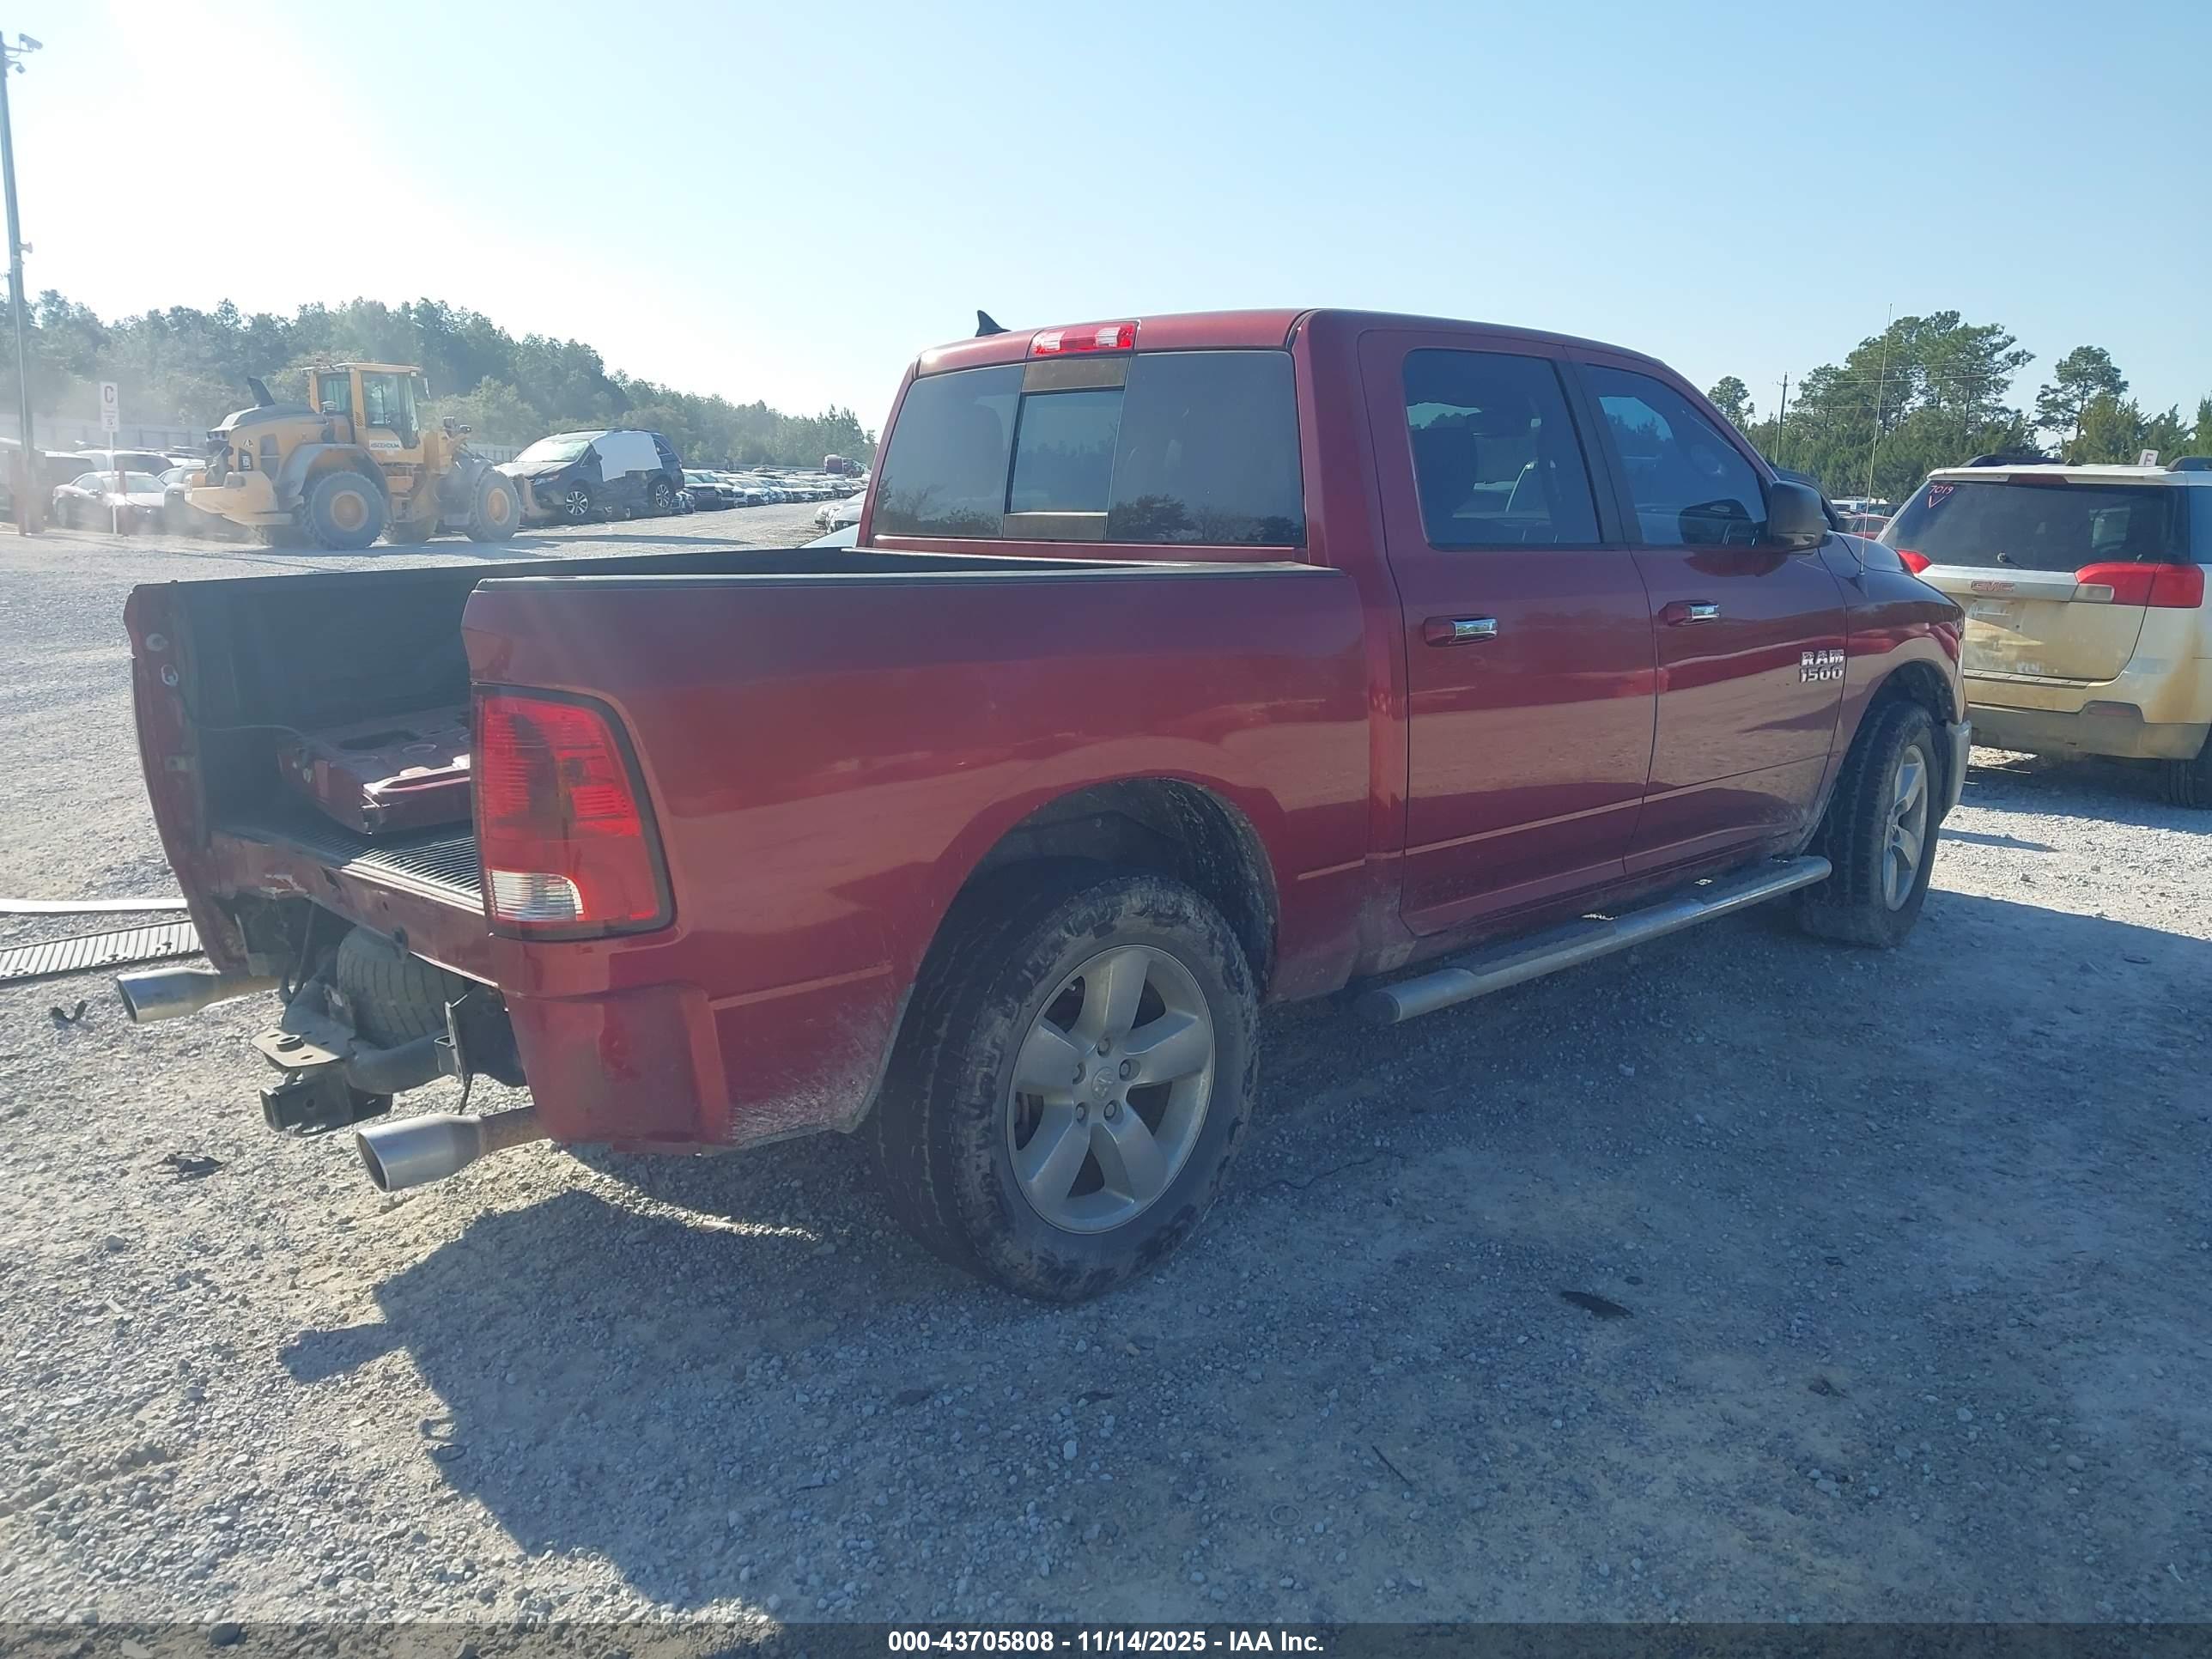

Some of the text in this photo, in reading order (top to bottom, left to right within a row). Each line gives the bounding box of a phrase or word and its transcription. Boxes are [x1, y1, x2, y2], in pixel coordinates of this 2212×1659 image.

[104, 385, 114, 404] C
[1929, 485, 1954, 495] 7019
[1971, 580, 2014, 592] GMC
[1801, 648, 1844, 665] RAM
[1800, 665, 1844, 683] 1500
